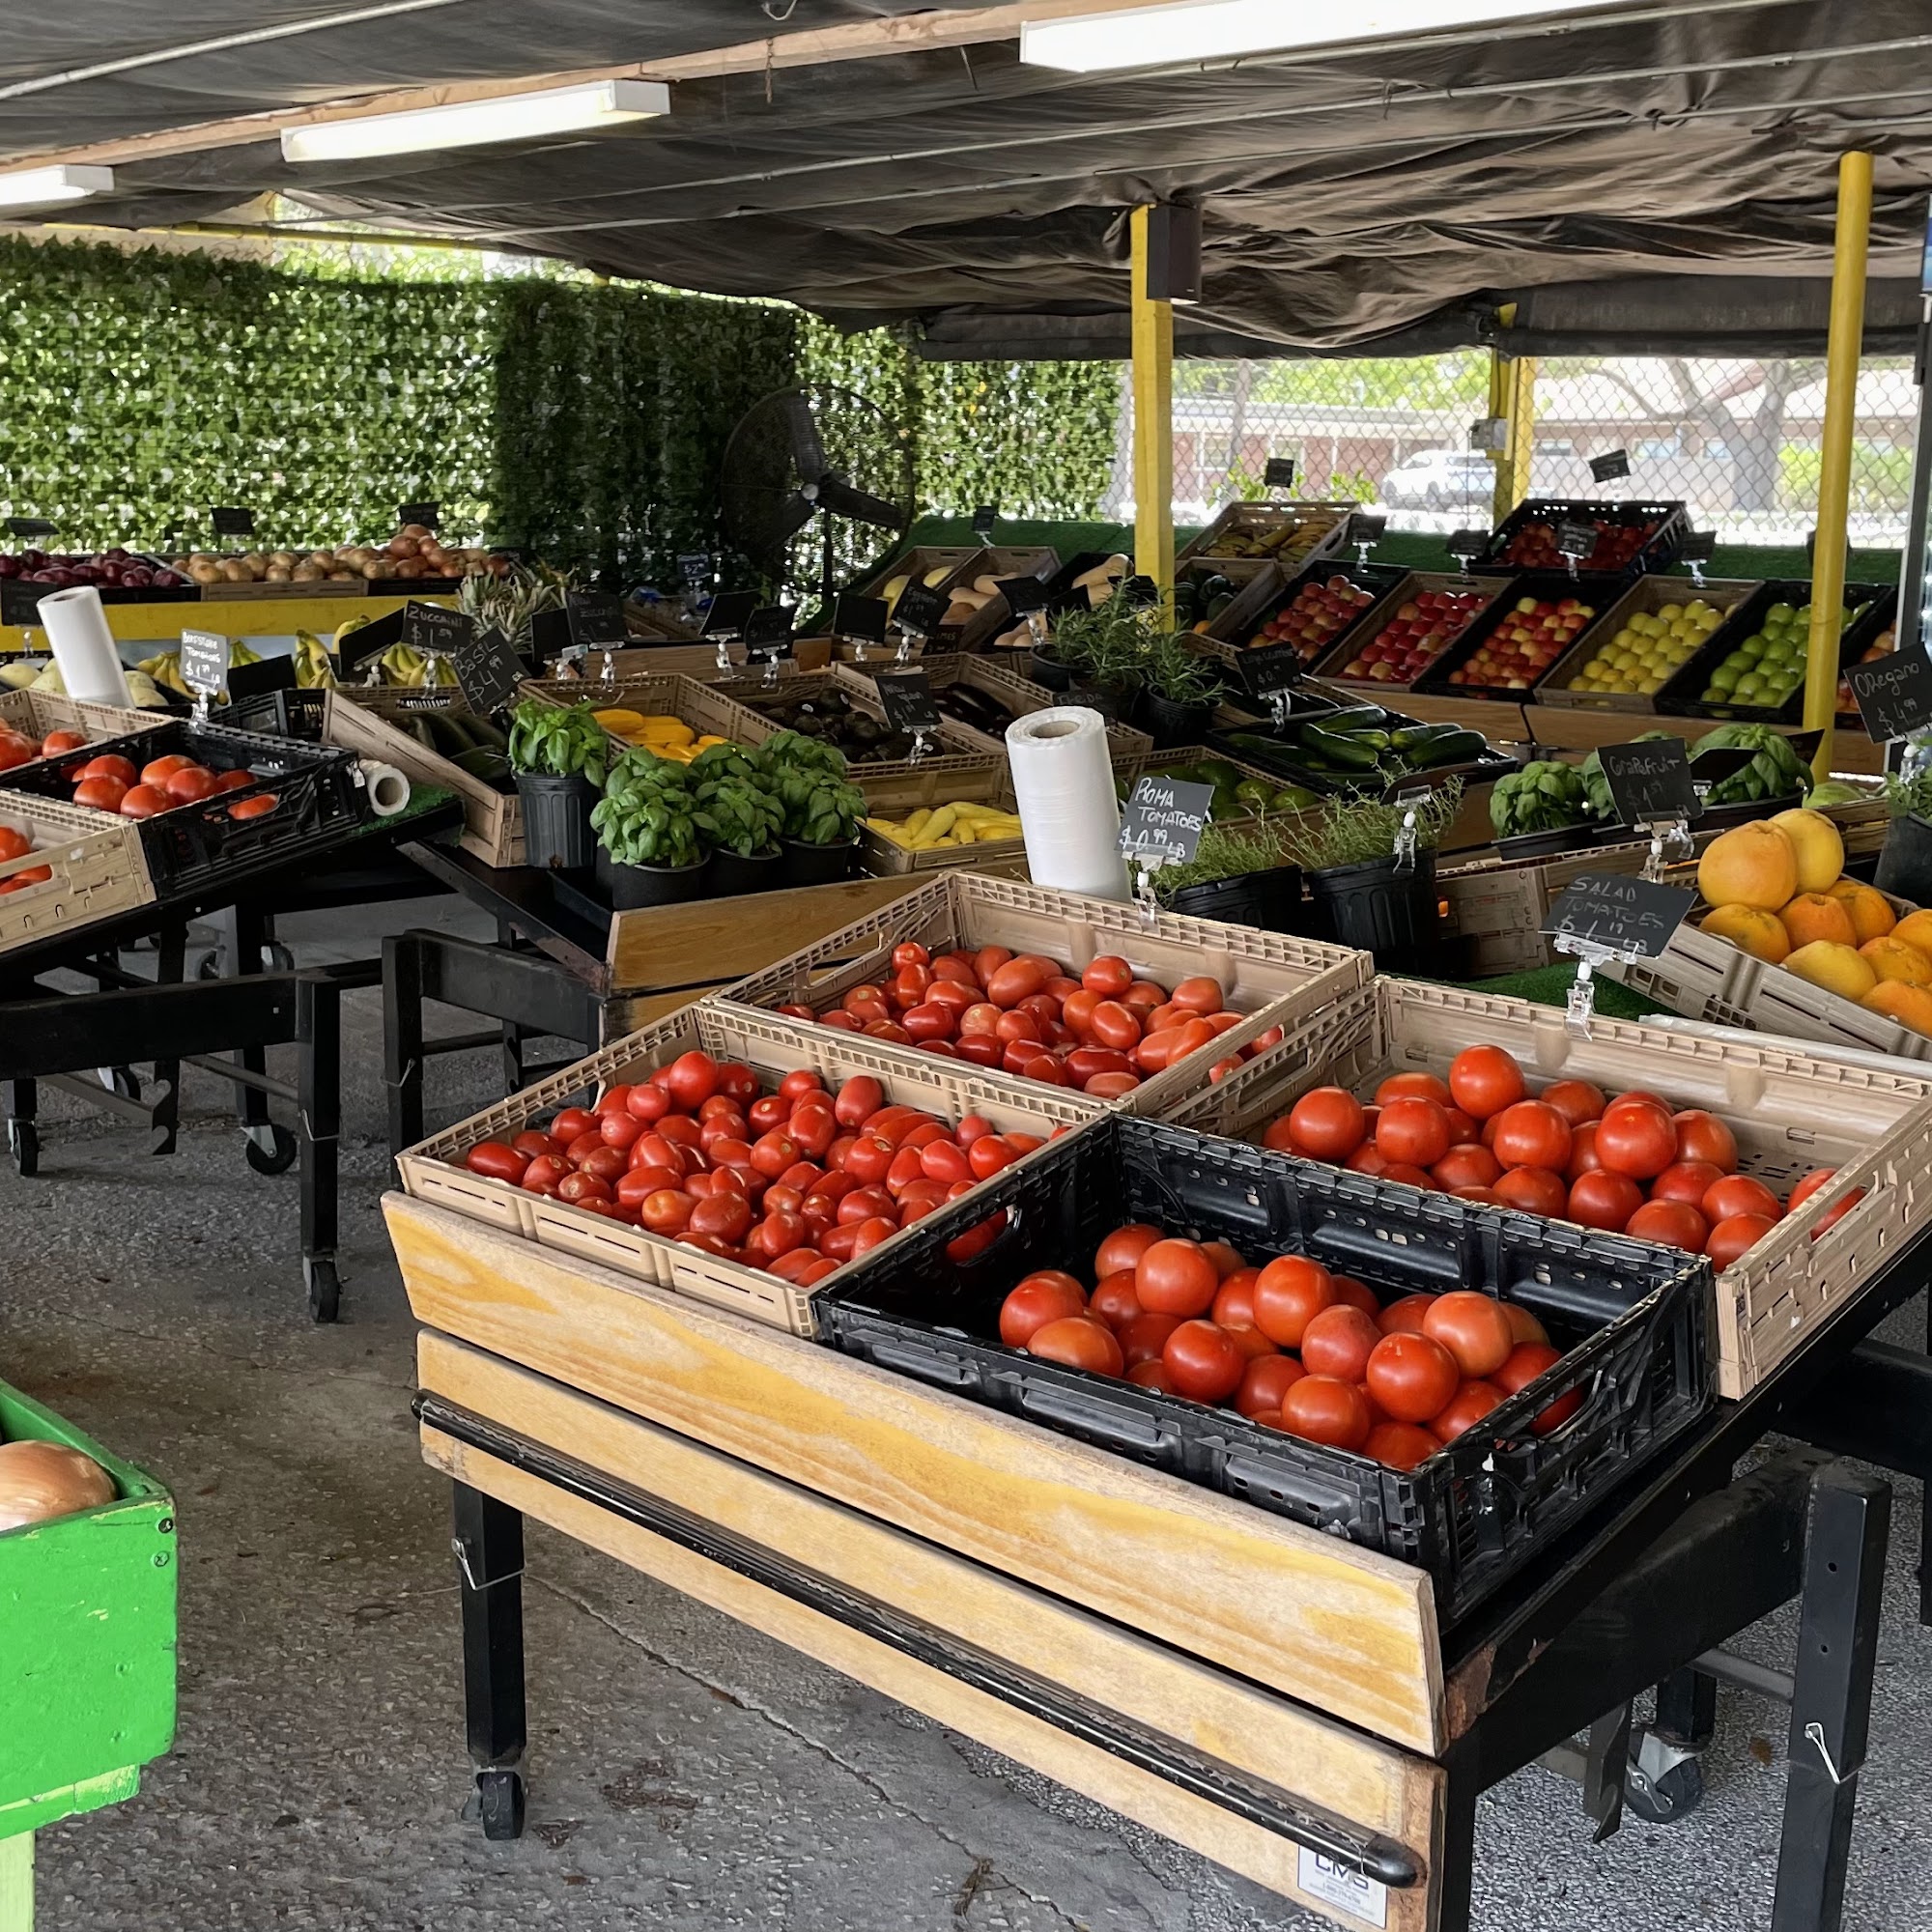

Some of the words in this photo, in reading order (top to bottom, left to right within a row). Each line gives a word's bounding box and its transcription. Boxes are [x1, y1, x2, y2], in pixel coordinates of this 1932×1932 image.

[1134, 777, 1174, 808] ROMA
[1138, 806, 1202, 833] TOMATOES
[1167, 841, 1186, 859] LB
[1569, 876, 1637, 902] SALAD
[1565, 895, 1665, 929] TOMATOES
